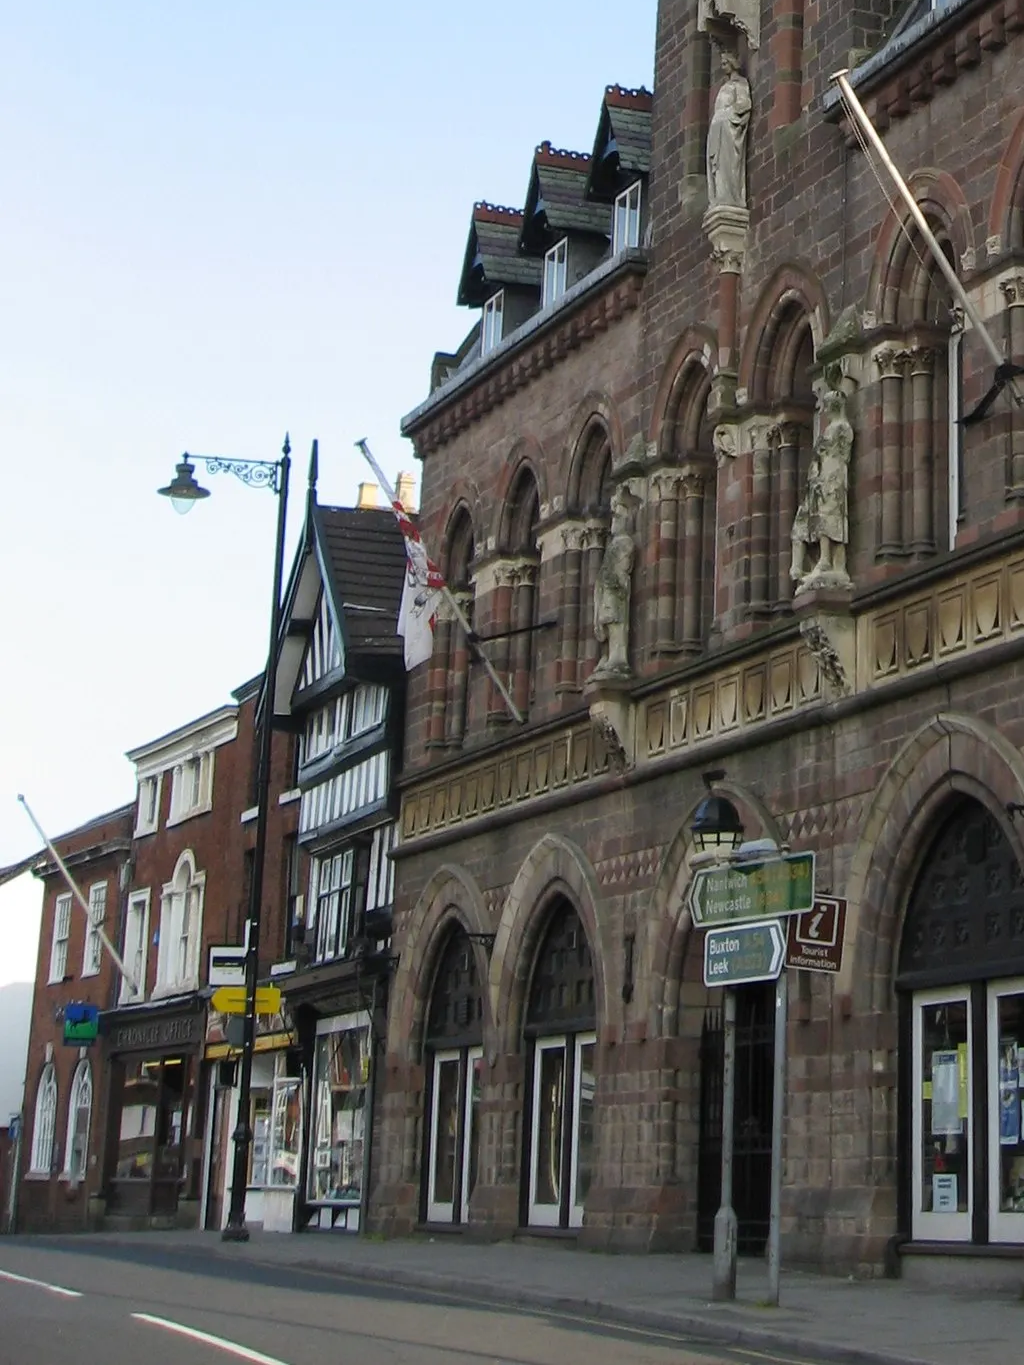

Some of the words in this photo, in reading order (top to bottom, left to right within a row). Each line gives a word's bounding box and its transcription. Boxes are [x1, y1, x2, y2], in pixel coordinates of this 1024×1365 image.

[706, 874, 748, 893] Nantwich
[706, 895, 751, 915] Newcastle
[709, 937, 739, 955] Buxton
[801, 945, 829, 958] Tourist
[708, 958, 729, 975] Leek
